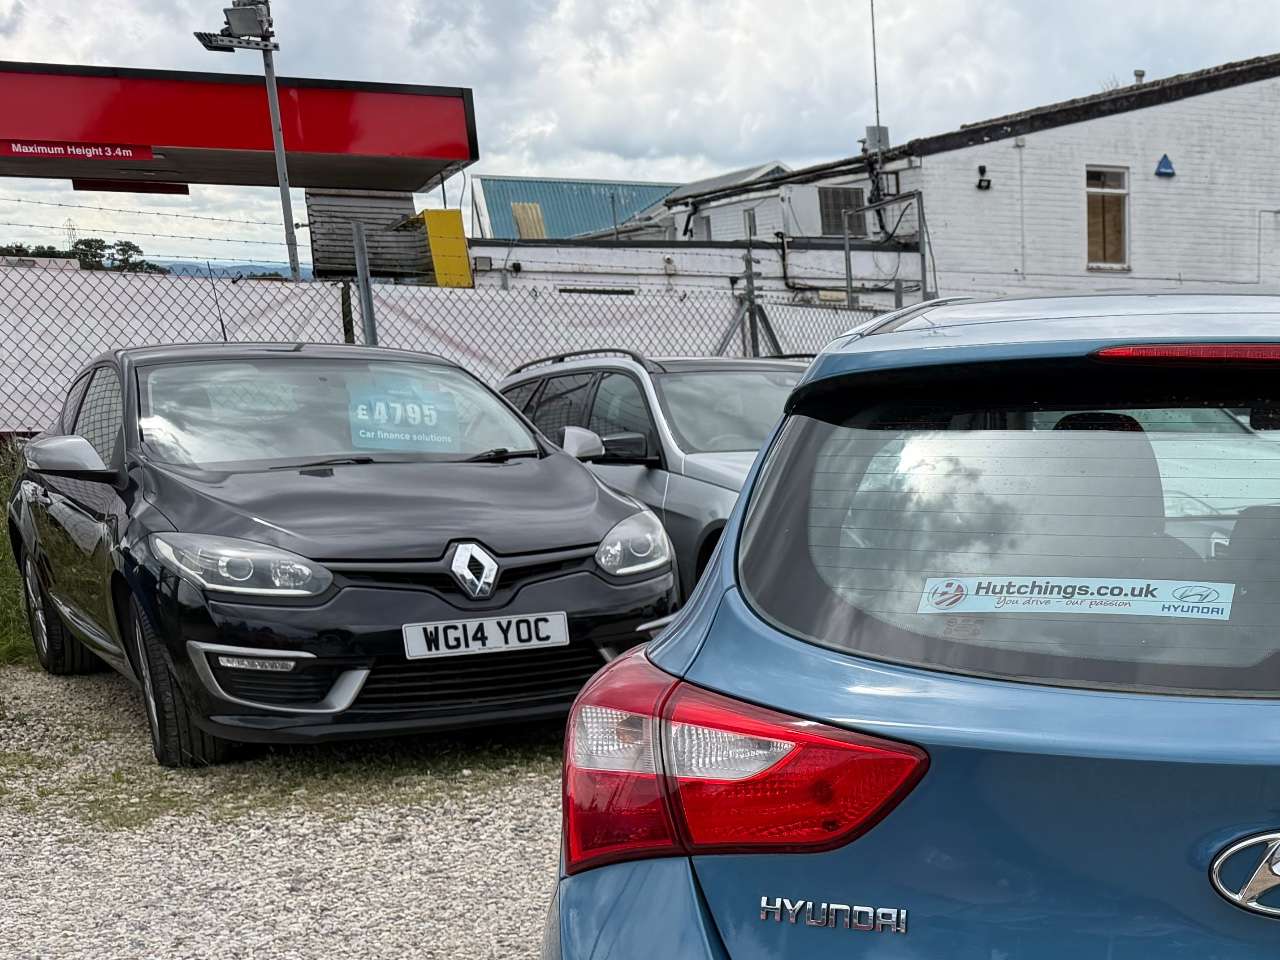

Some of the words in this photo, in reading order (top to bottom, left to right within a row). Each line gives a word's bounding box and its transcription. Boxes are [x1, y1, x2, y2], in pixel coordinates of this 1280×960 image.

[11, 143, 65, 155] Maximum
[67, 146, 103, 158] Height
[104, 147, 133, 157] 3.4m
[359, 430, 375, 439] Car
[377, 430, 411, 441] finance
[412, 432, 453, 443] solutions
[975, 581, 1159, 600] Hutchings.co.uk
[994, 596, 1019, 609] You
[1022, 596, 1051, 606] drive
[1088, 600, 1132, 609] passion
[1161, 604, 1225, 616] HYUNDAI
[422, 621, 489, 652] WG14
[496, 617, 552, 645] YOC
[760, 896, 908, 934] HYUNDAI
